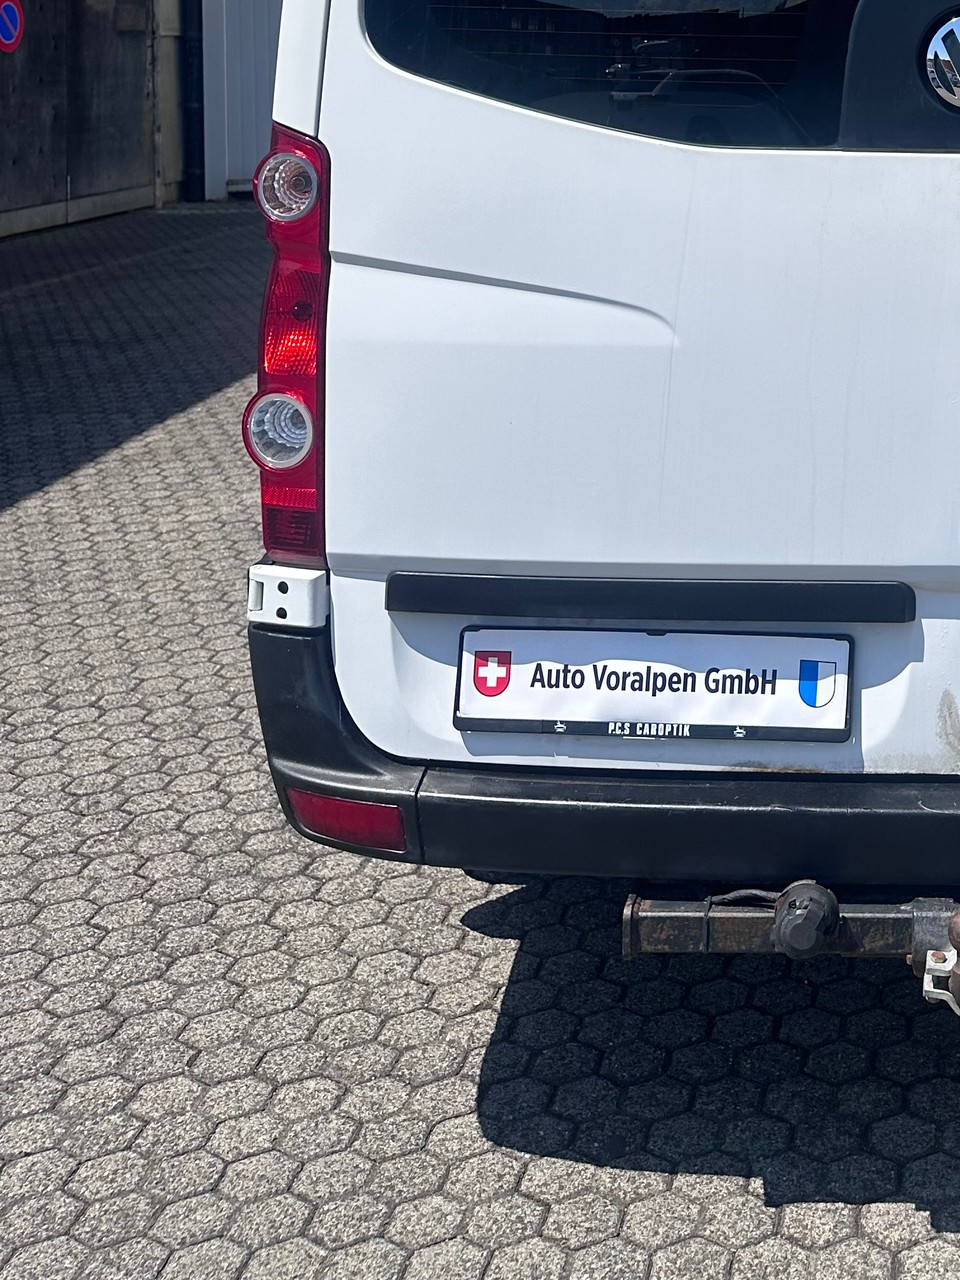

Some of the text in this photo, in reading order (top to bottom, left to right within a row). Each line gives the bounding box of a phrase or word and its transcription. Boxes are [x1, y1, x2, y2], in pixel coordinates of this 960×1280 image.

[530, 662, 778, 697] Auto Voralpen GmbH
[636, 722, 692, 738] CAROPTIK
